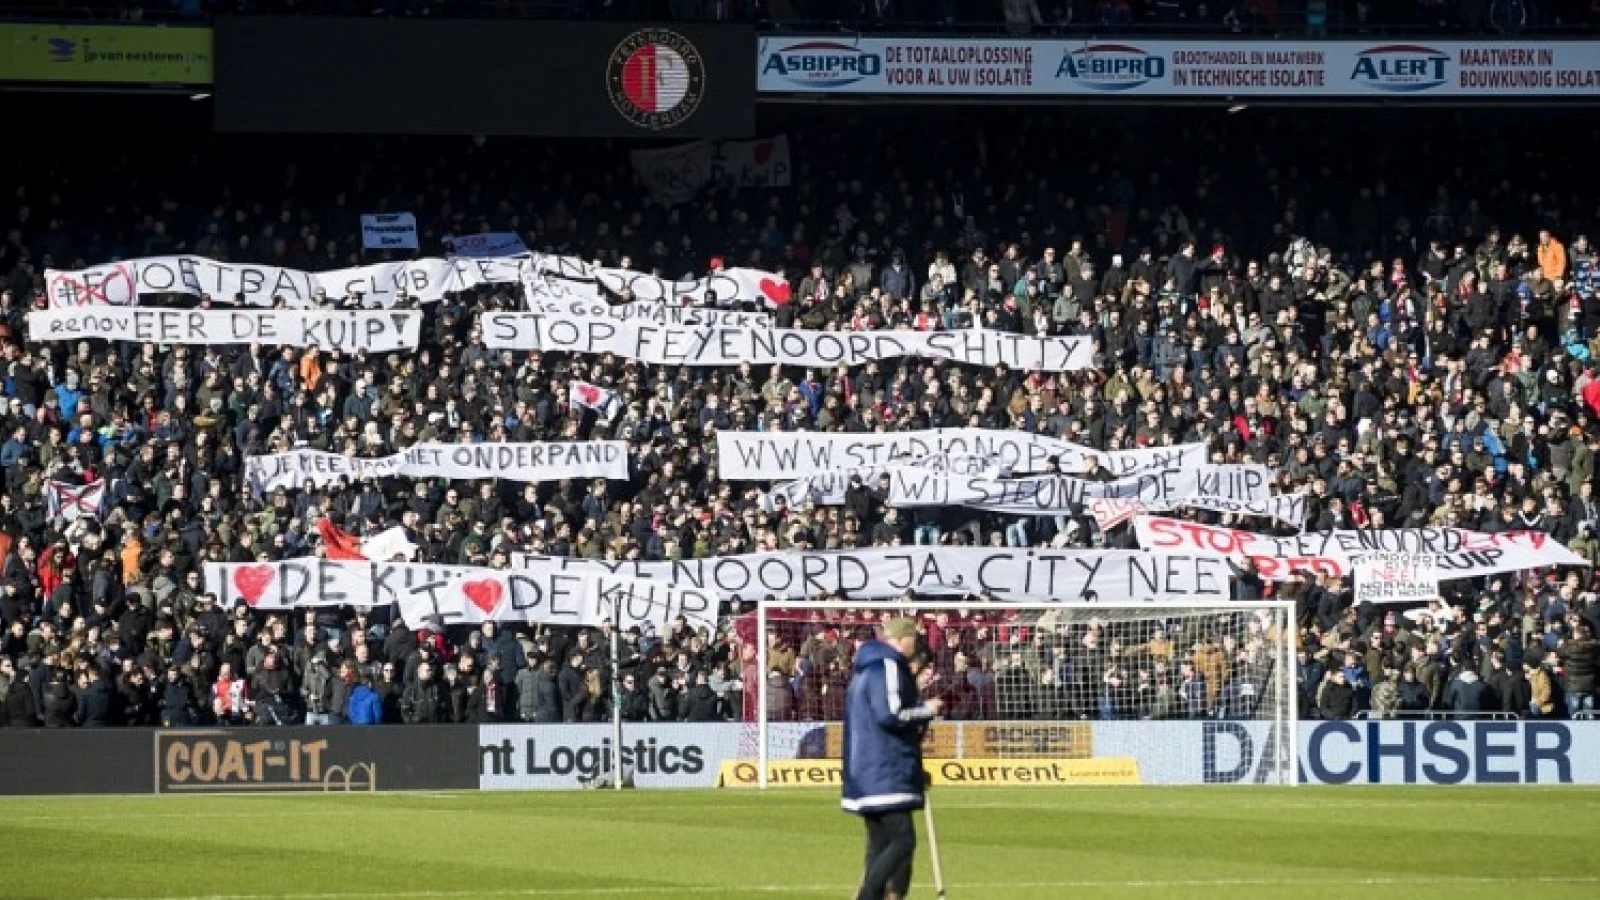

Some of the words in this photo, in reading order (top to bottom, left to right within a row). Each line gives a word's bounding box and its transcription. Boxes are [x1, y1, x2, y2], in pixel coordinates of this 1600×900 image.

[761, 53, 881, 76] ASBIPRO
[886, 46, 902, 64] DE
[906, 46, 1032, 65] TOTAALOPLOSSING
[1055, 55, 1165, 78] ASBIPRO
[1172, 50, 1248, 65] GROOTHANDEL
[1251, 51, 1263, 65] EN
[1266, 50, 1325, 66] MAATWERK
[1459, 49, 1534, 67] MAATWERK
[1537, 49, 1554, 67] IN
[886, 68, 924, 86] VOOR
[928, 68, 944, 86] AL
[948, 68, 971, 86] UW
[975, 68, 1032, 86] ISOLATIE
[1172, 69, 1188, 87] IN
[1190, 69, 1266, 87] TECHNISCHE
[1270, 69, 1325, 86] ISOLATIE
[1350, 57, 1452, 80] ALERT
[1459, 70, 1552, 89] BOUWKUNDIG
[231, 313, 277, 340] DE
[492, 313, 616, 352] STOP
[635, 325, 906, 362] FEYENOORD
[451, 443, 620, 471] ONDERPAND
[1148, 518, 1258, 559] STOP
[219, 566, 230, 605] I
[279, 561, 348, 605] DE
[1129, 555, 1222, 597] NEE
[509, 574, 581, 616] DE
[166, 739, 328, 782] COAT-IT
[526, 737, 703, 781] Logistics
[1201, 721, 1573, 784] DACHSER
[733, 762, 844, 784] Qurren
[940, 762, 1067, 783] Qurrent
